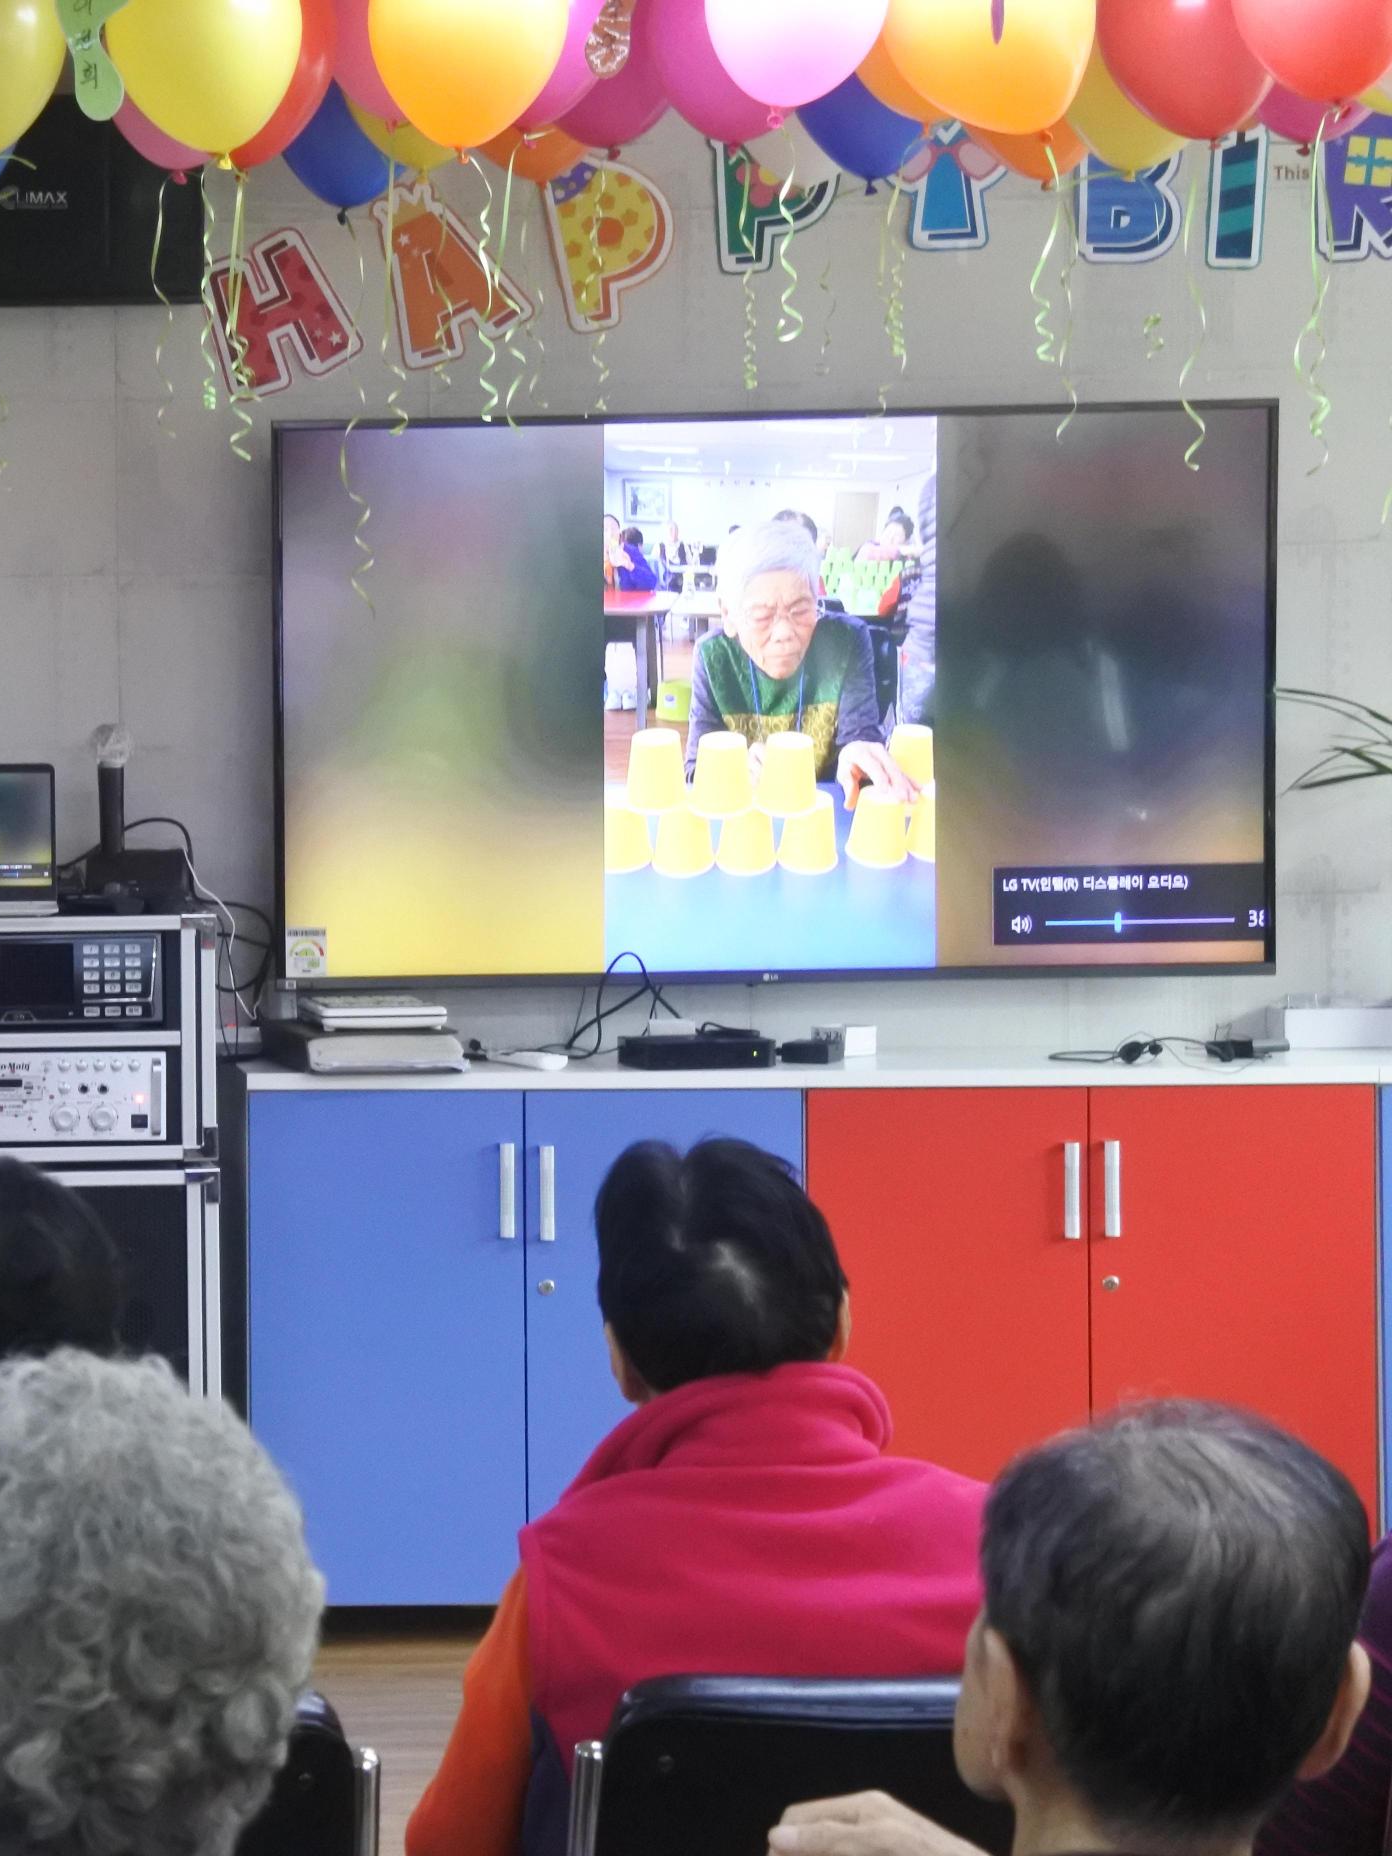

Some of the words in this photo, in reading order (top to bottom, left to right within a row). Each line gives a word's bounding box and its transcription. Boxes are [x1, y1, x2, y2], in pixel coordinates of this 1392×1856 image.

[1273, 165, 1309, 181] This
[1003, 879, 1017, 892] LG
[1083, 875, 1143, 890] 디스플레이
